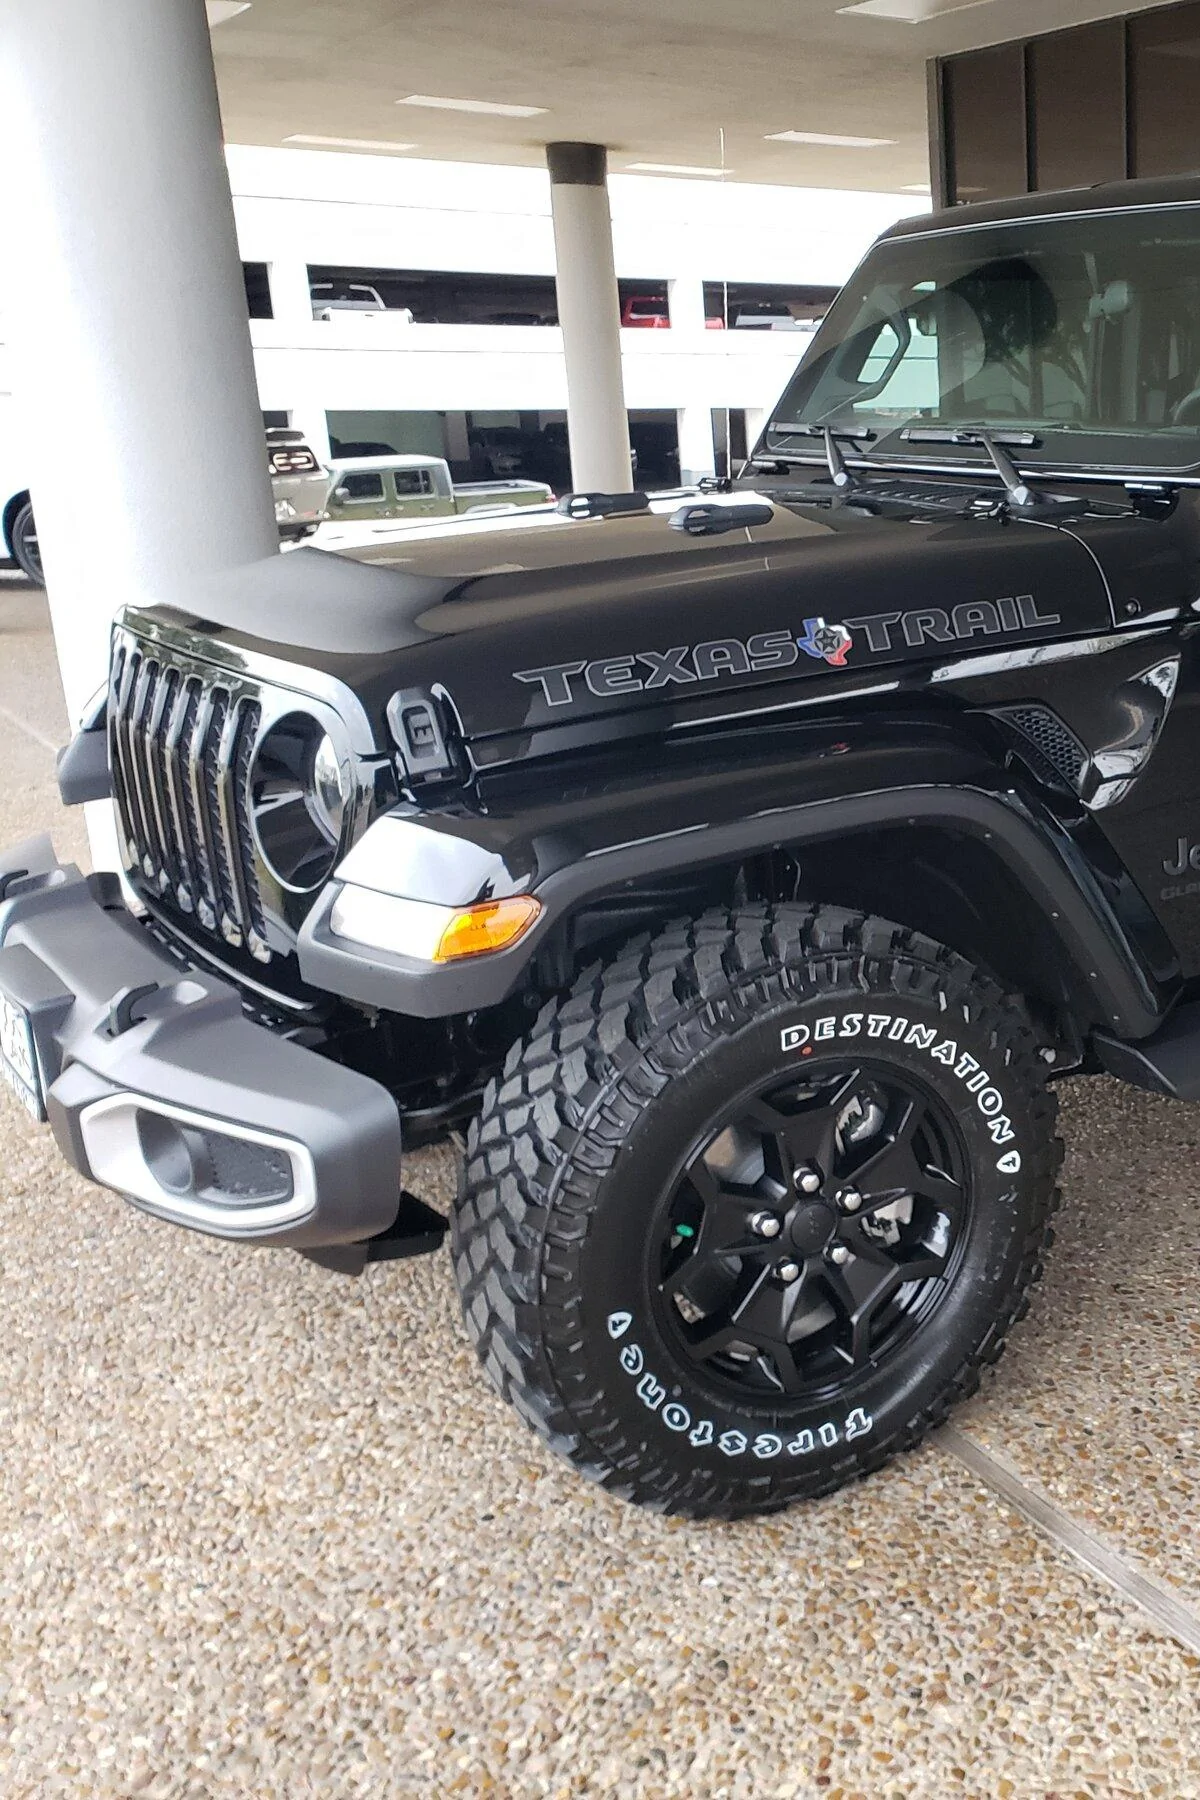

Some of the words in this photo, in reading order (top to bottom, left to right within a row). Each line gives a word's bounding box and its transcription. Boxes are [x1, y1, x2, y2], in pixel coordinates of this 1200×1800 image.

[513, 629, 798, 706] TEXAS
[842, 594, 1061, 652] TRAIL
[780, 1013, 1016, 1145] DESTINATION
[620, 1343, 873, 1459] Firestone
